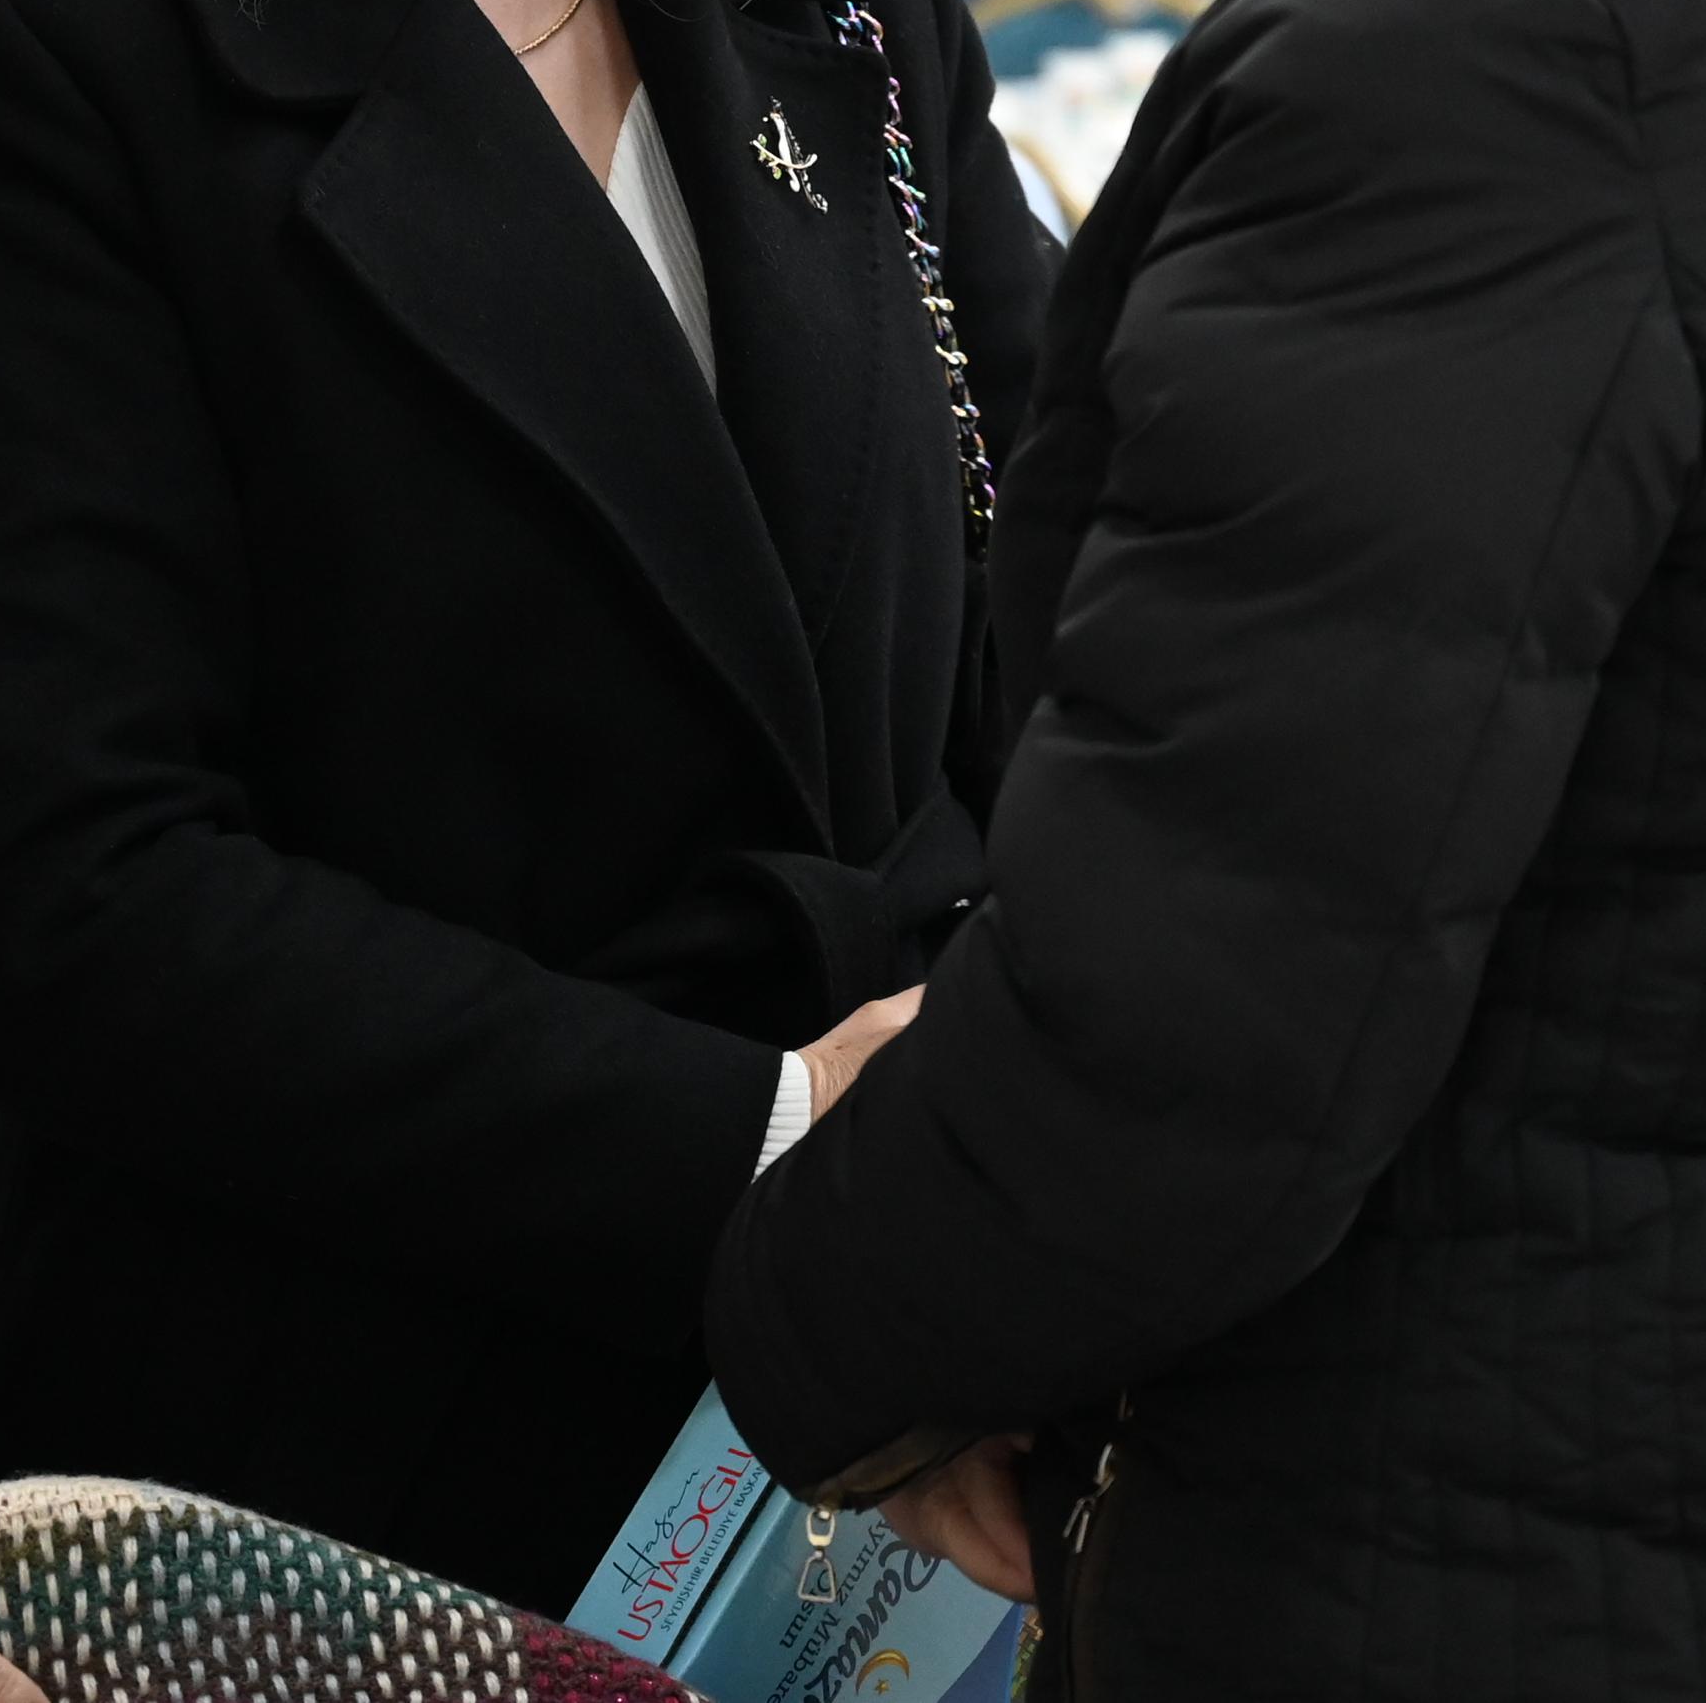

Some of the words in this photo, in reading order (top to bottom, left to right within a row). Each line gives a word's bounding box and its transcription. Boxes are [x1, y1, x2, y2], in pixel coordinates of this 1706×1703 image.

[613, 1469, 700, 1594] Hasan
[779, 1569, 834, 1648] Osun
[804, 1541, 941, 1703] Ramaz
